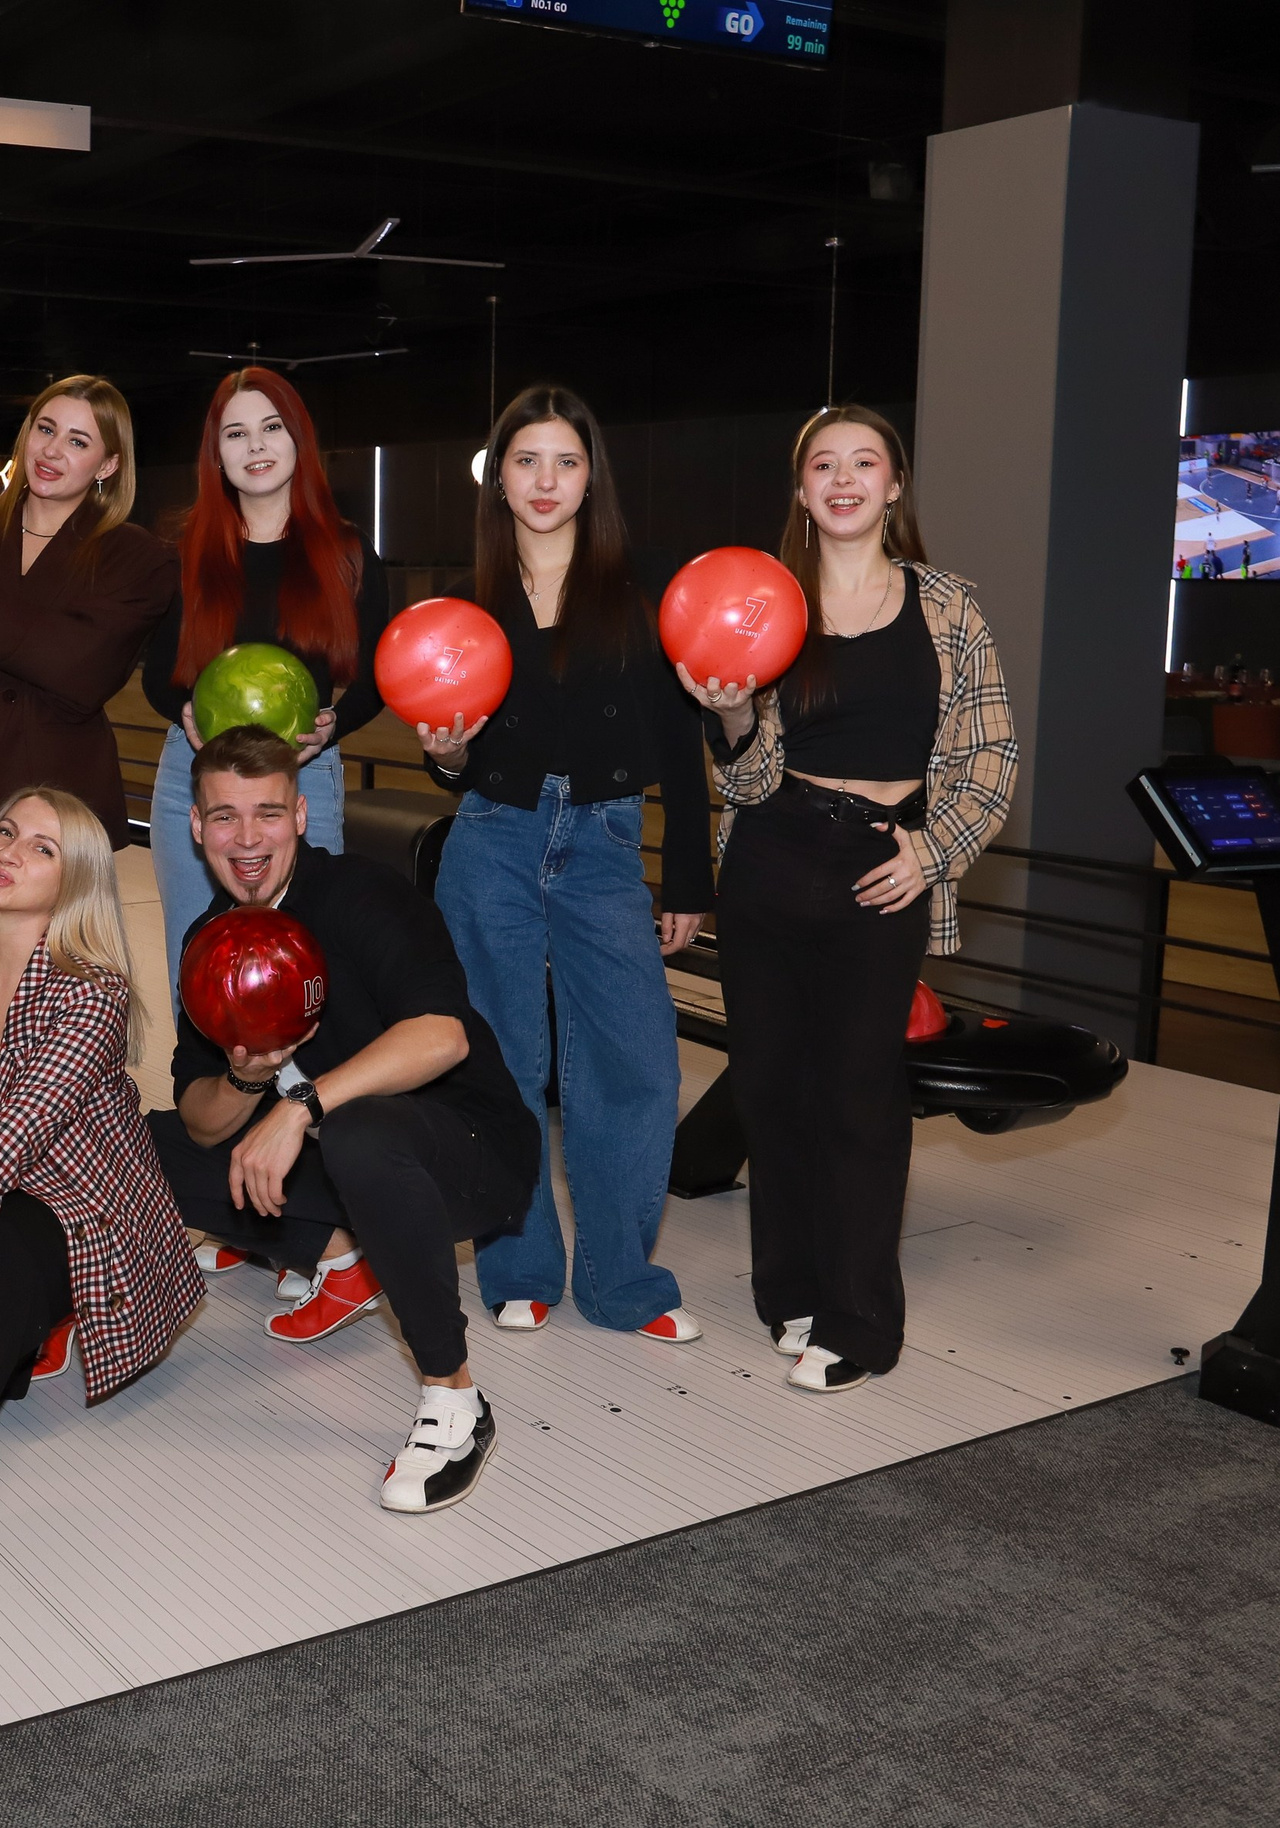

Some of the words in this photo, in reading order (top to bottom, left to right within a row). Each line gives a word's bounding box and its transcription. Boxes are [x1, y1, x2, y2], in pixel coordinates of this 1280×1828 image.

[554, 2, 568, 13] GO
[725, 12, 754, 36] GO
[786, 15, 828, 32] Remaining
[787, 34, 803, 51] 99
[804, 38, 825, 55] min
[742, 597, 767, 627] 7
[441, 646, 464, 676] 7
[303, 976, 324, 1010] 10
